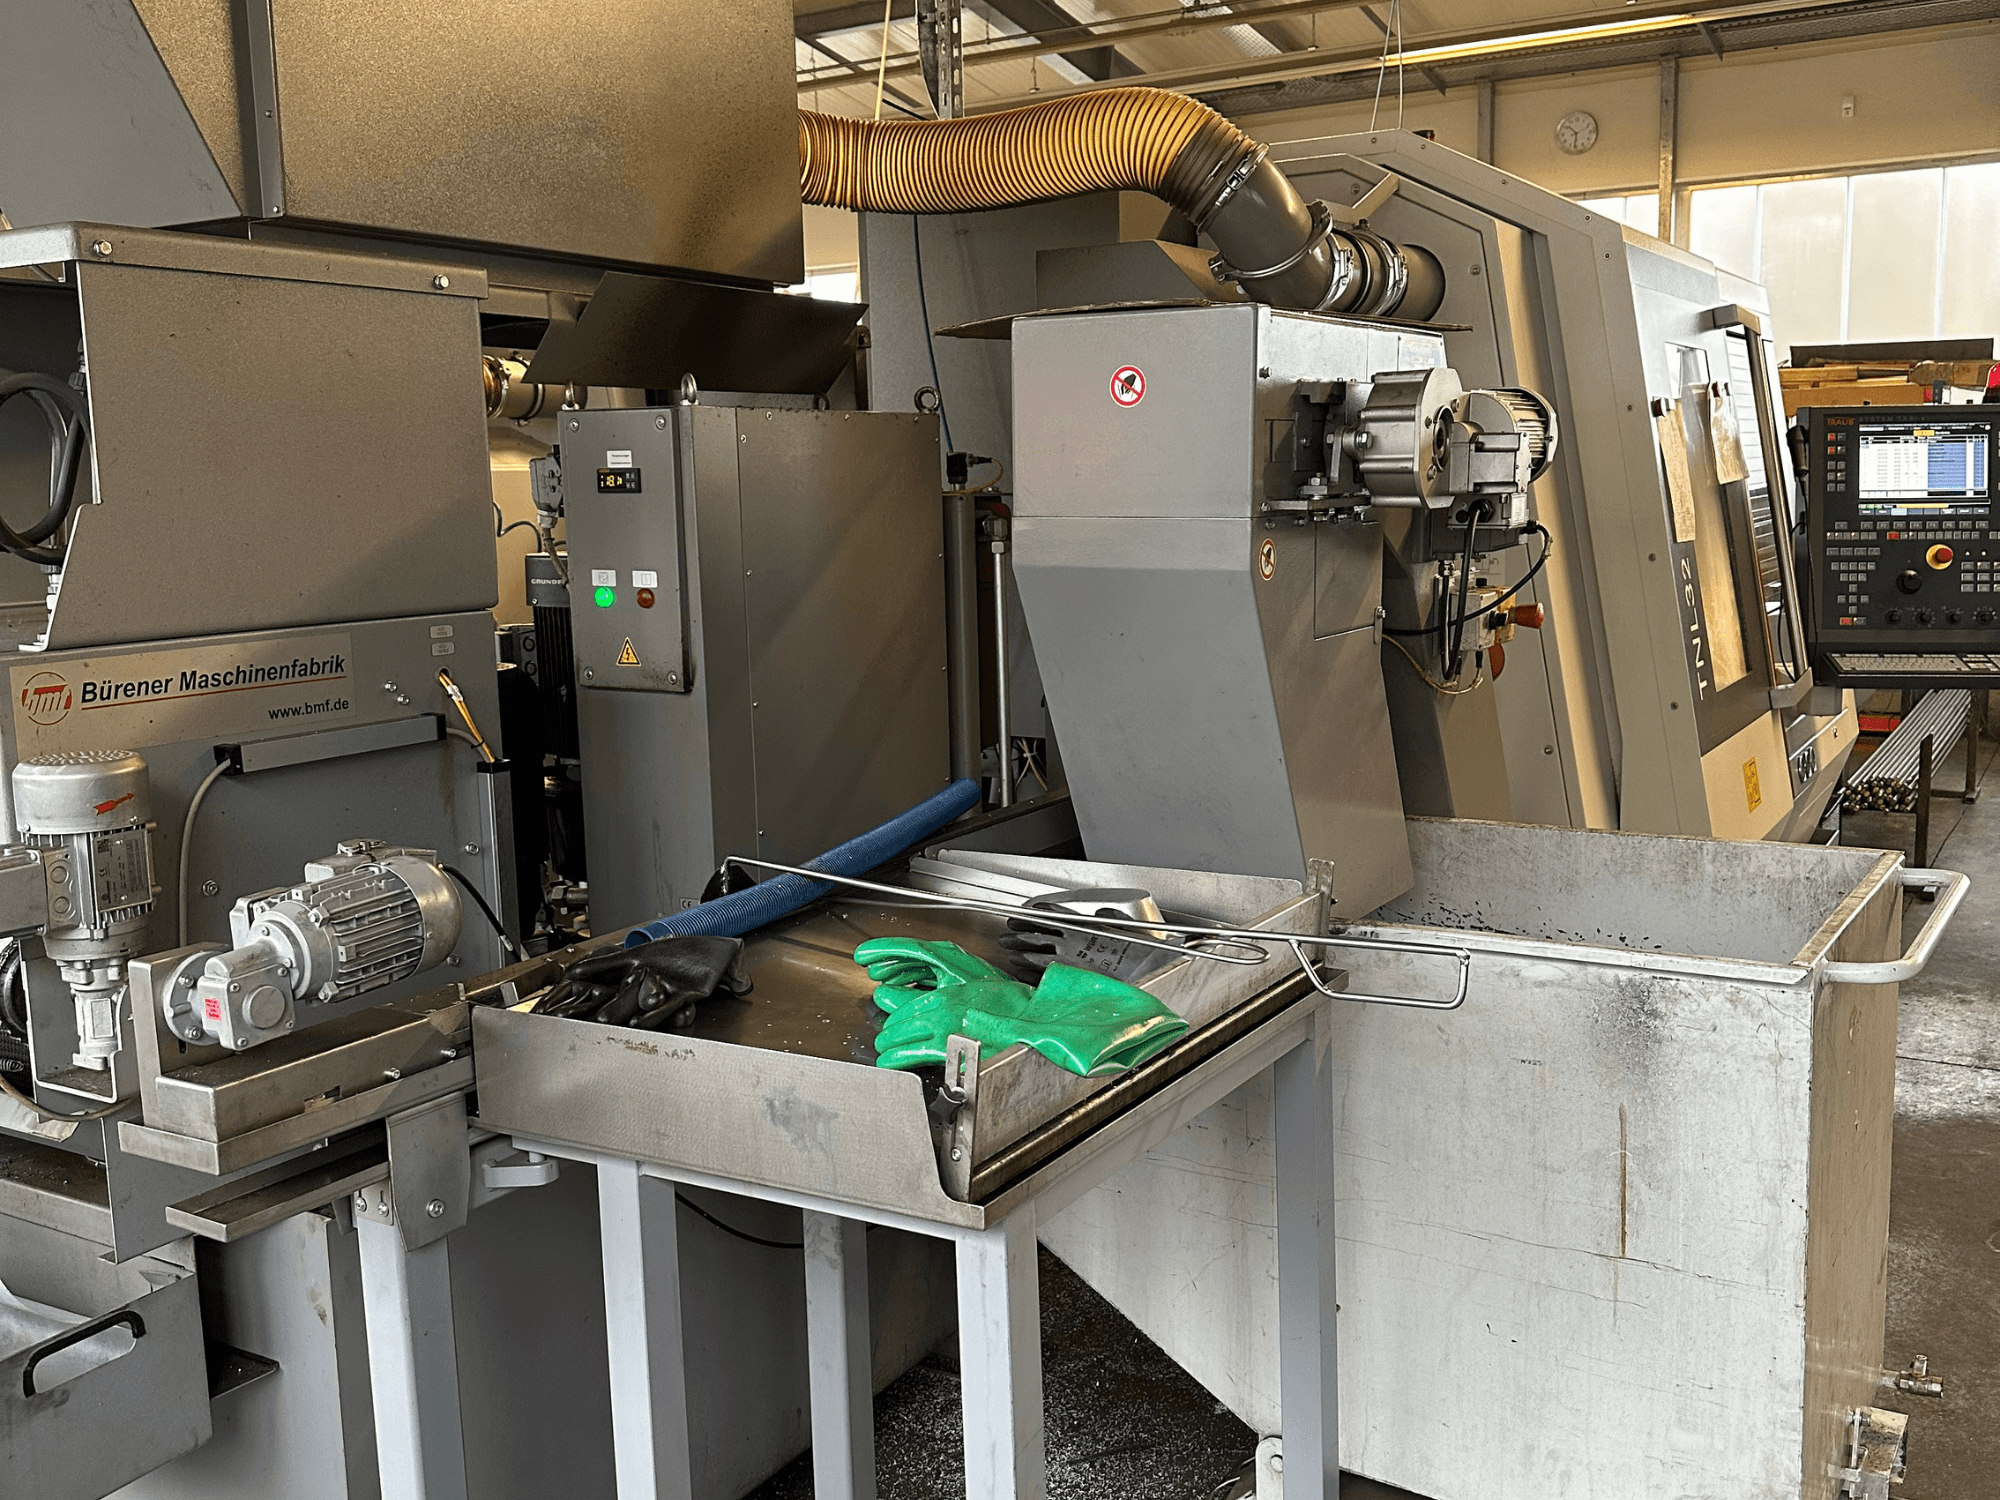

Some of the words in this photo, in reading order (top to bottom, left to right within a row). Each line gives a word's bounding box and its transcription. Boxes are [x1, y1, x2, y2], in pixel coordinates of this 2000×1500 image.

[1681, 557, 1708, 701] TNL32
[81, 677, 174, 704] Bürener
[179, 655, 346, 692] Maschinenfabrik
[268, 698, 350, 719] www.bmf.de
